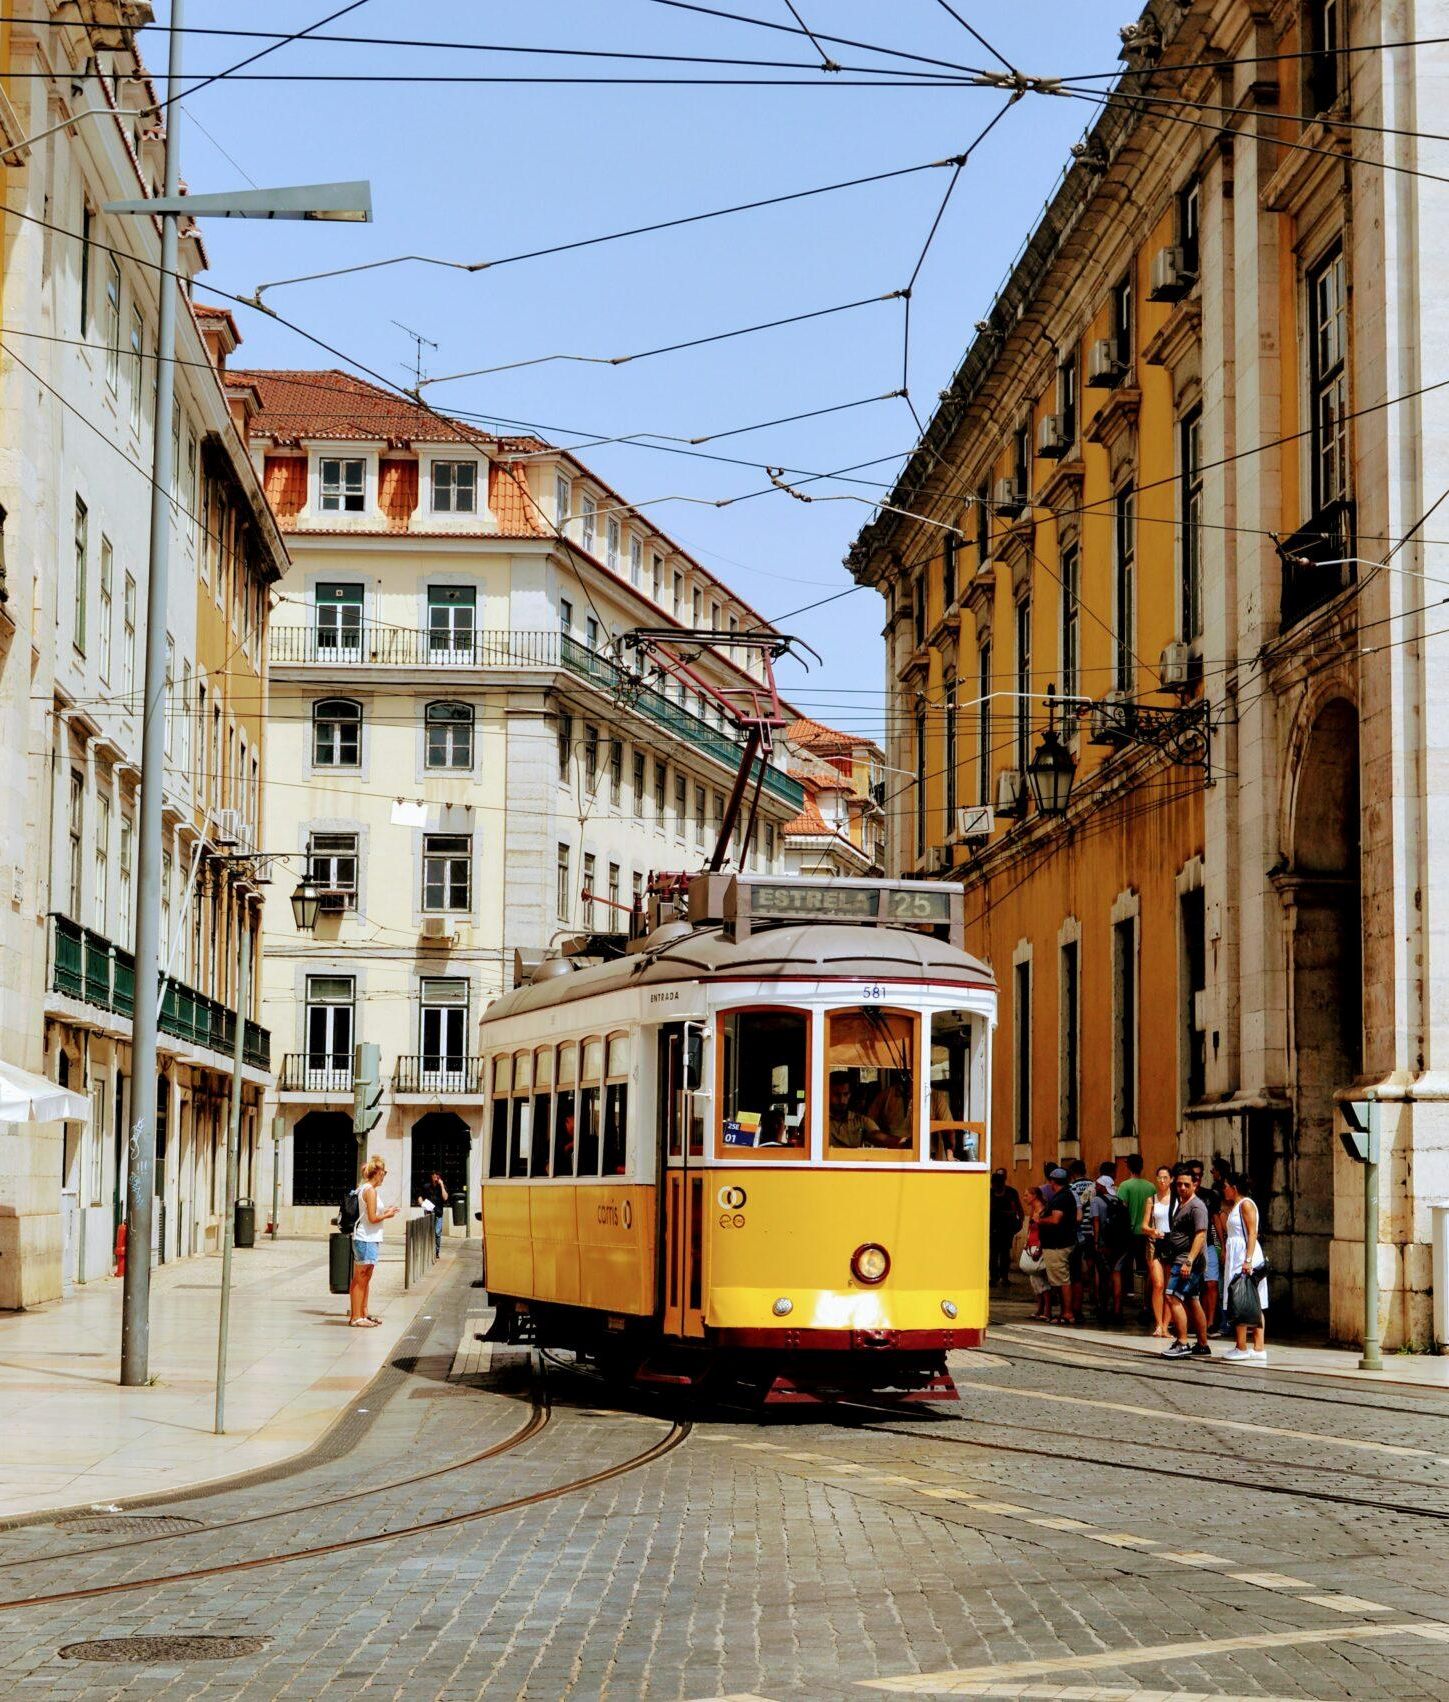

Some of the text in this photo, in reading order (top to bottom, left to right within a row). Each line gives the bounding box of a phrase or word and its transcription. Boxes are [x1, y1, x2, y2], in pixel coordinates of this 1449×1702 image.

[759, 888, 869, 910] ESTRELA
[894, 892, 931, 916] 25
[650, 991, 679, 1003] ENTRADA
[863, 986, 886, 999] 581
[725, 1133, 736, 1143] 01
